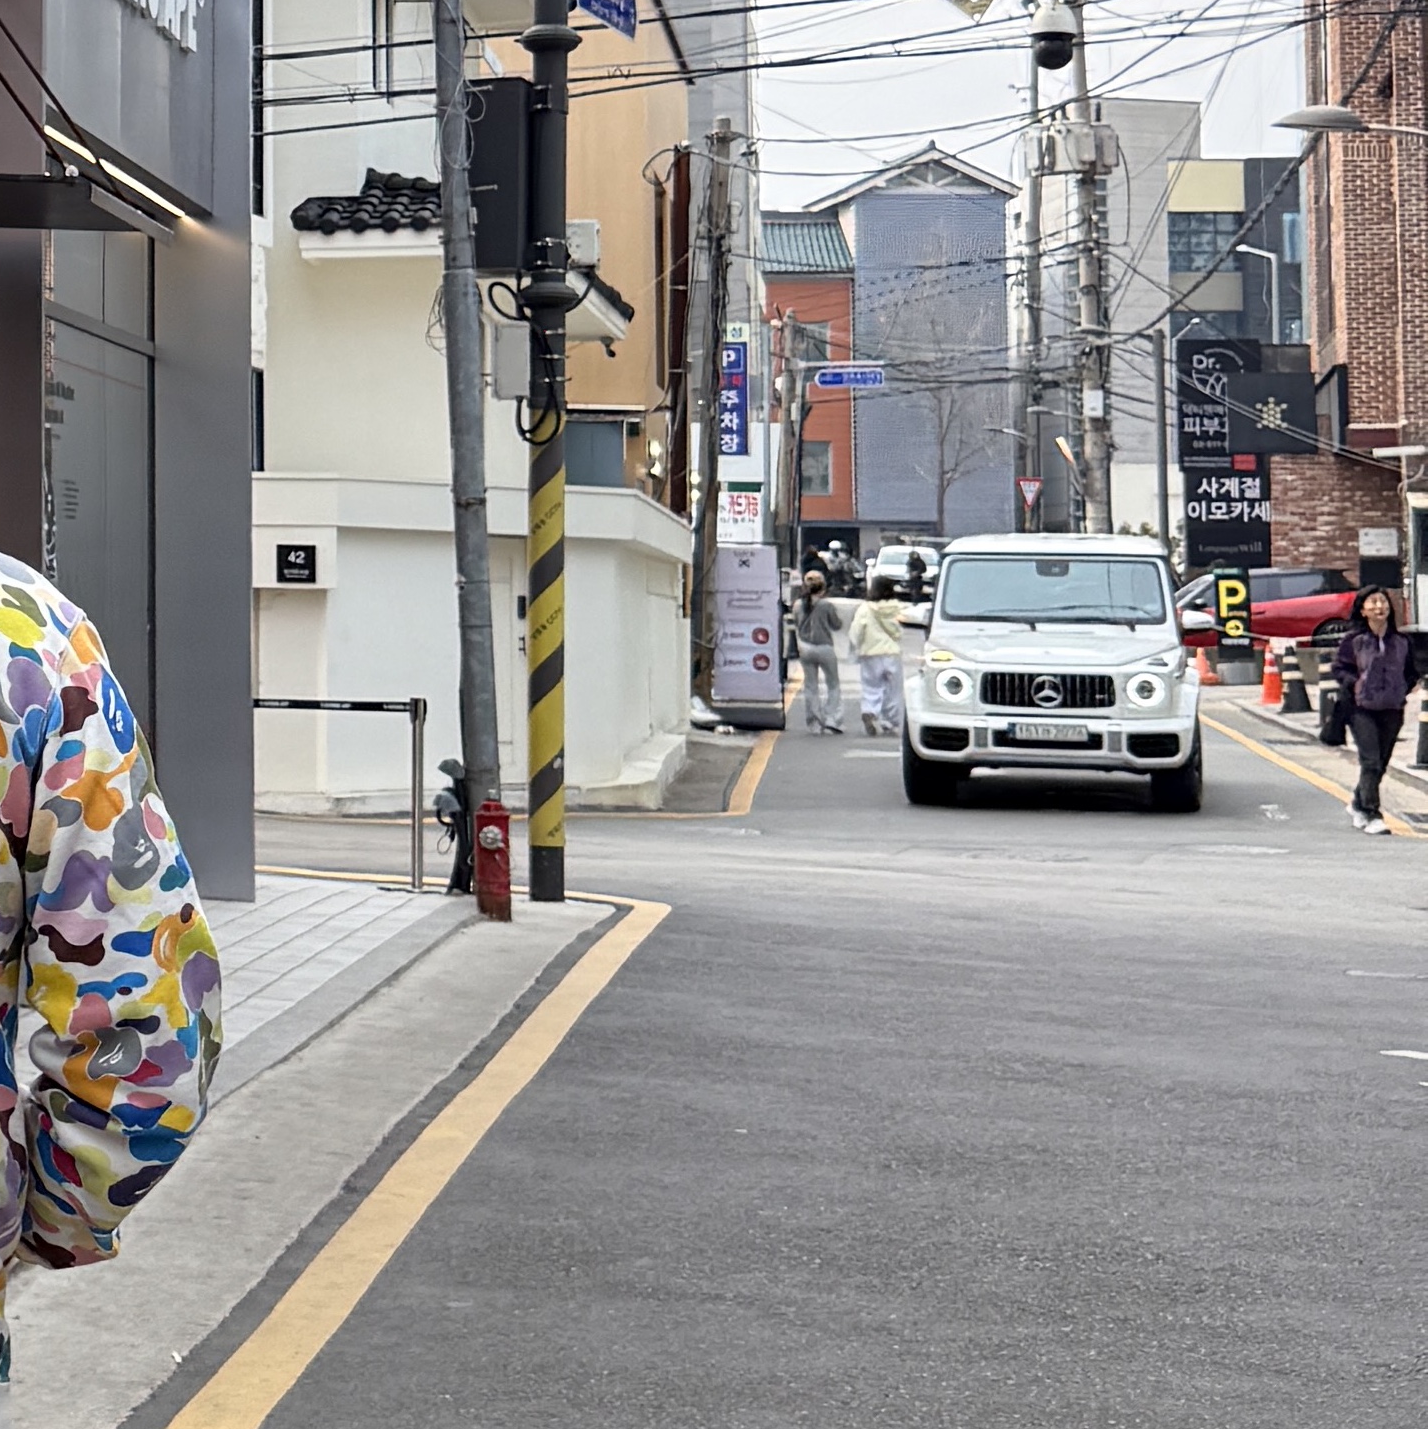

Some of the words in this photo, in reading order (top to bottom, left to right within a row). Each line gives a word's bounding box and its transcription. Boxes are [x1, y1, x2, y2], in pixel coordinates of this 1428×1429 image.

[722, 349, 736, 367] P
[1192, 354, 1221, 370] Dr.
[719, 389, 740, 453] 주차장
[1197, 476, 1261, 499] 사계절
[1187, 500, 1270, 522] 이모카세
[287, 550, 305, 565] 42
[1218, 579, 1247, 619] P
